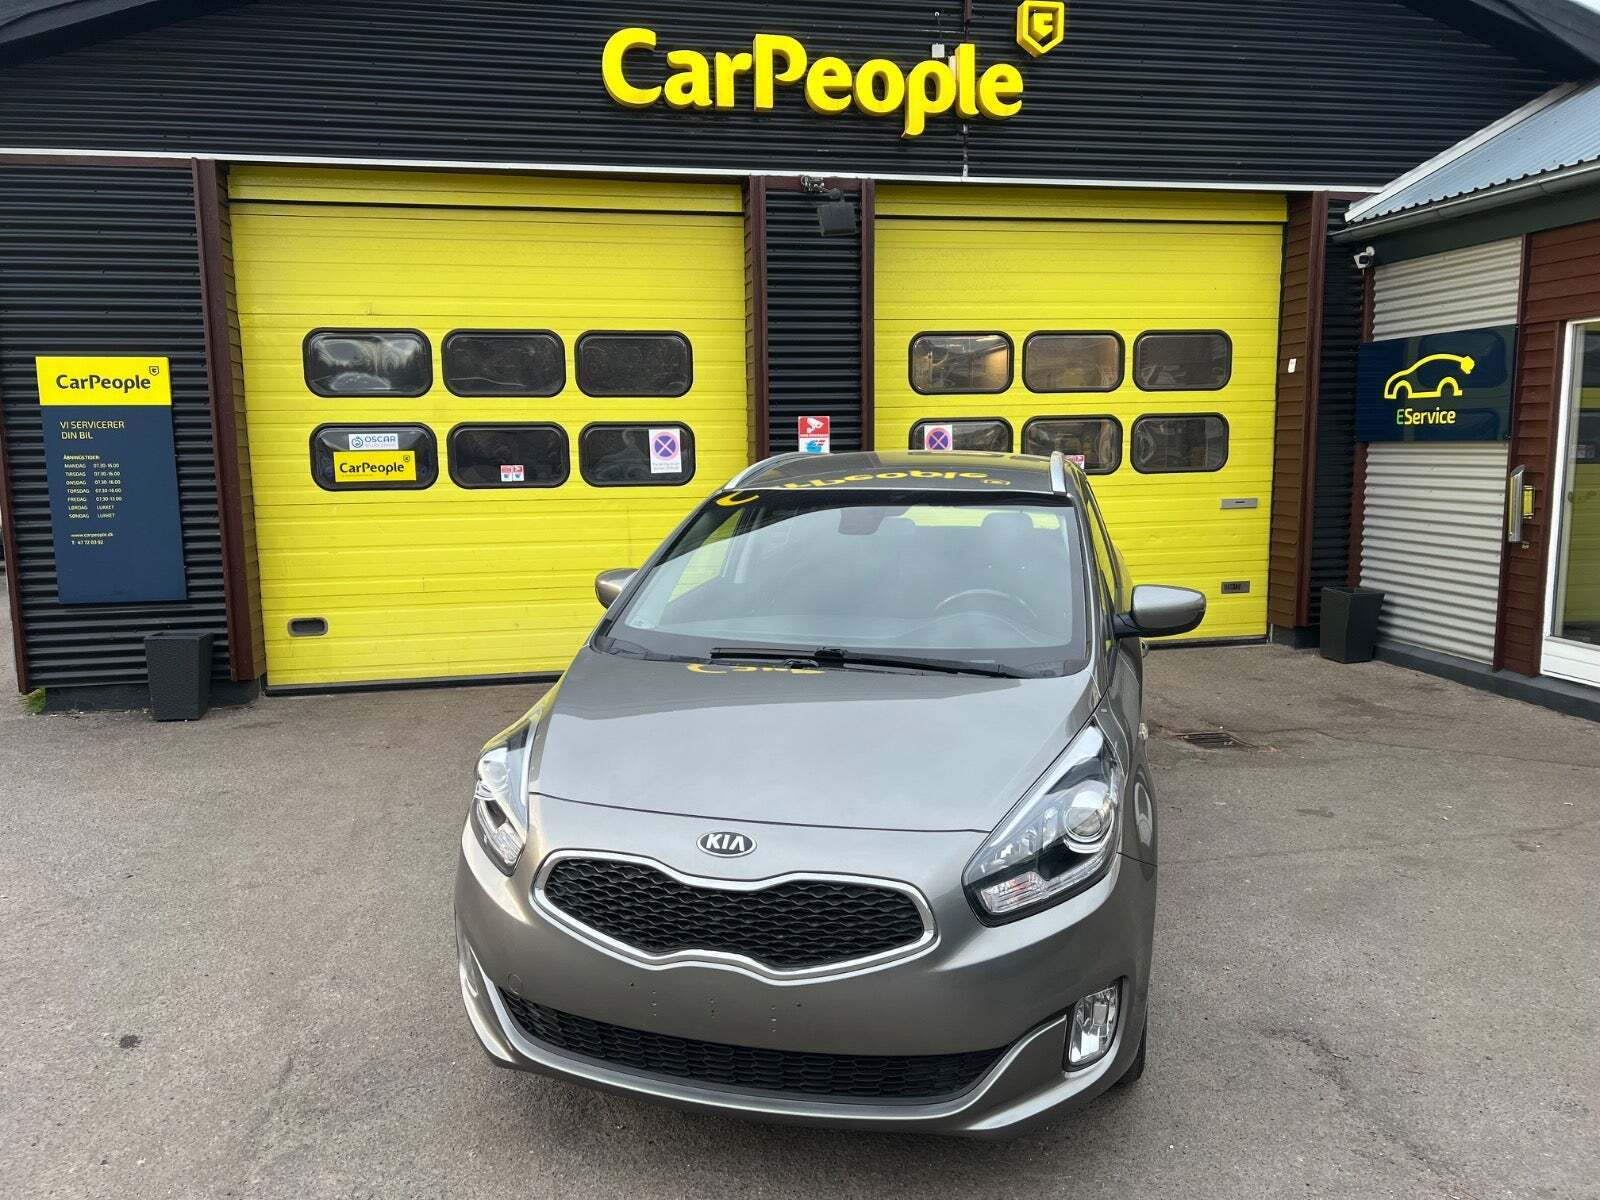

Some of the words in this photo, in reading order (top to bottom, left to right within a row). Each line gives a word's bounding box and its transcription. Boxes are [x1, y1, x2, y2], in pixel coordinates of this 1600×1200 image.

[601, 27, 1024, 139] CarPeople
[56, 374, 151, 394] CarPeople
[1396, 407, 1456, 425] EService
[60, 420, 69, 429] VI
[71, 420, 125, 429] SERVICERER
[61, 431, 77, 440] DIN
[79, 431, 93, 440] BIL
[364, 435, 396, 443] OSCAR
[339, 461, 405, 476] CarPeople
[705, 833, 745, 852] KIA
